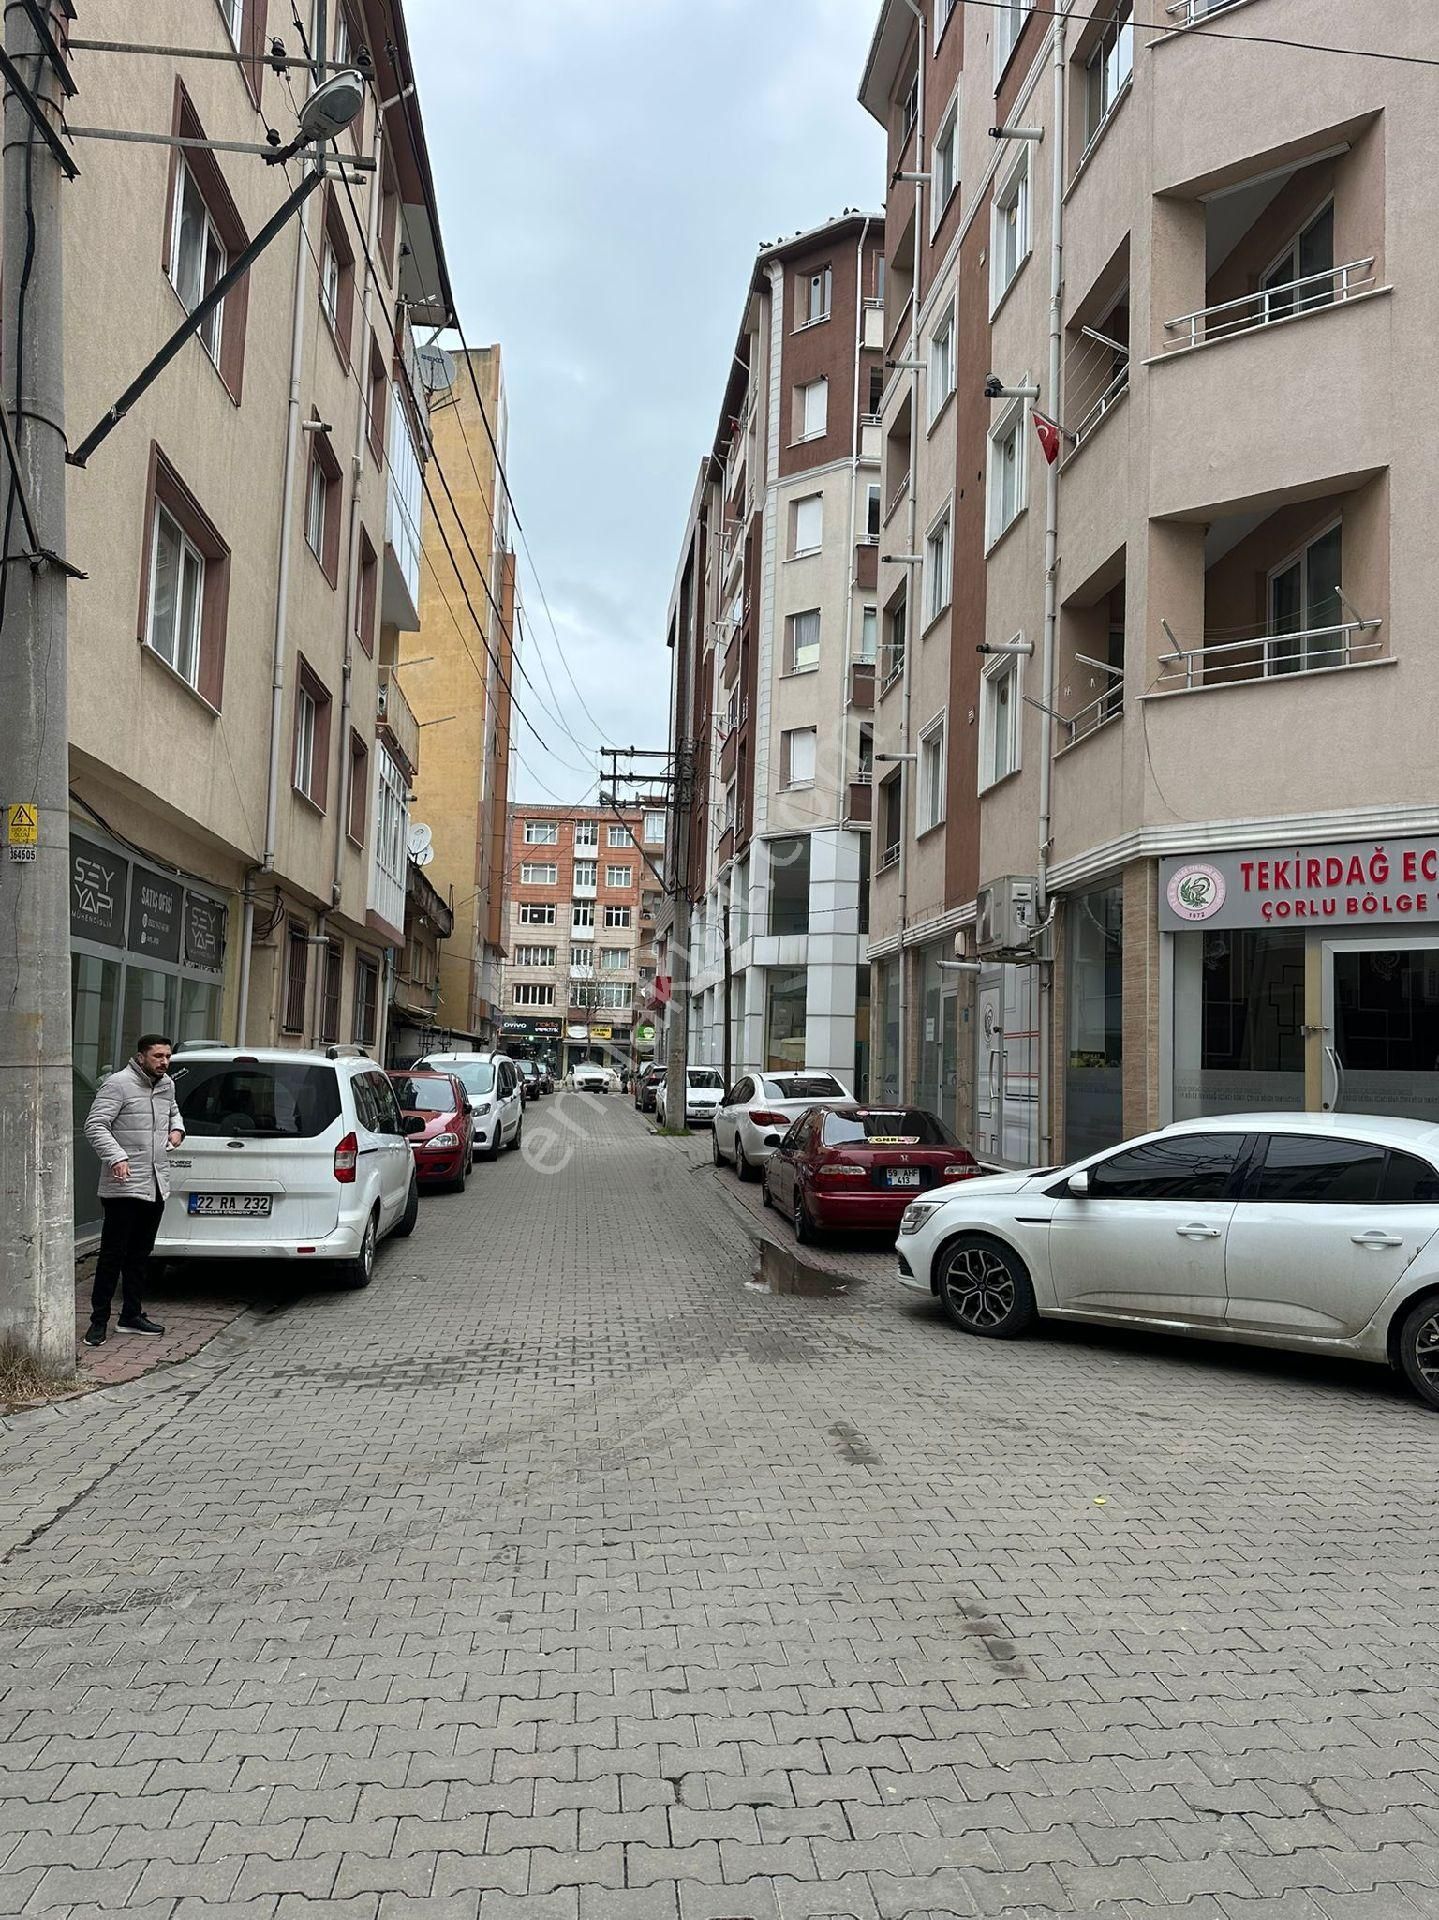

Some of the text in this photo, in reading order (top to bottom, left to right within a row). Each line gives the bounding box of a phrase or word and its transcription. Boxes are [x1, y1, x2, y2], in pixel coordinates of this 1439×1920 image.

[75, 857, 115, 892] SEY
[1241, 846, 1389, 892] TEKİRDAĞ
[74, 883, 114, 919] YAPI
[1262, 892, 1427, 922] ÇORLU BÖLGE
[887, 1169, 898, 1177] 59
[198, 1196, 268, 1210] 22 RA 232
